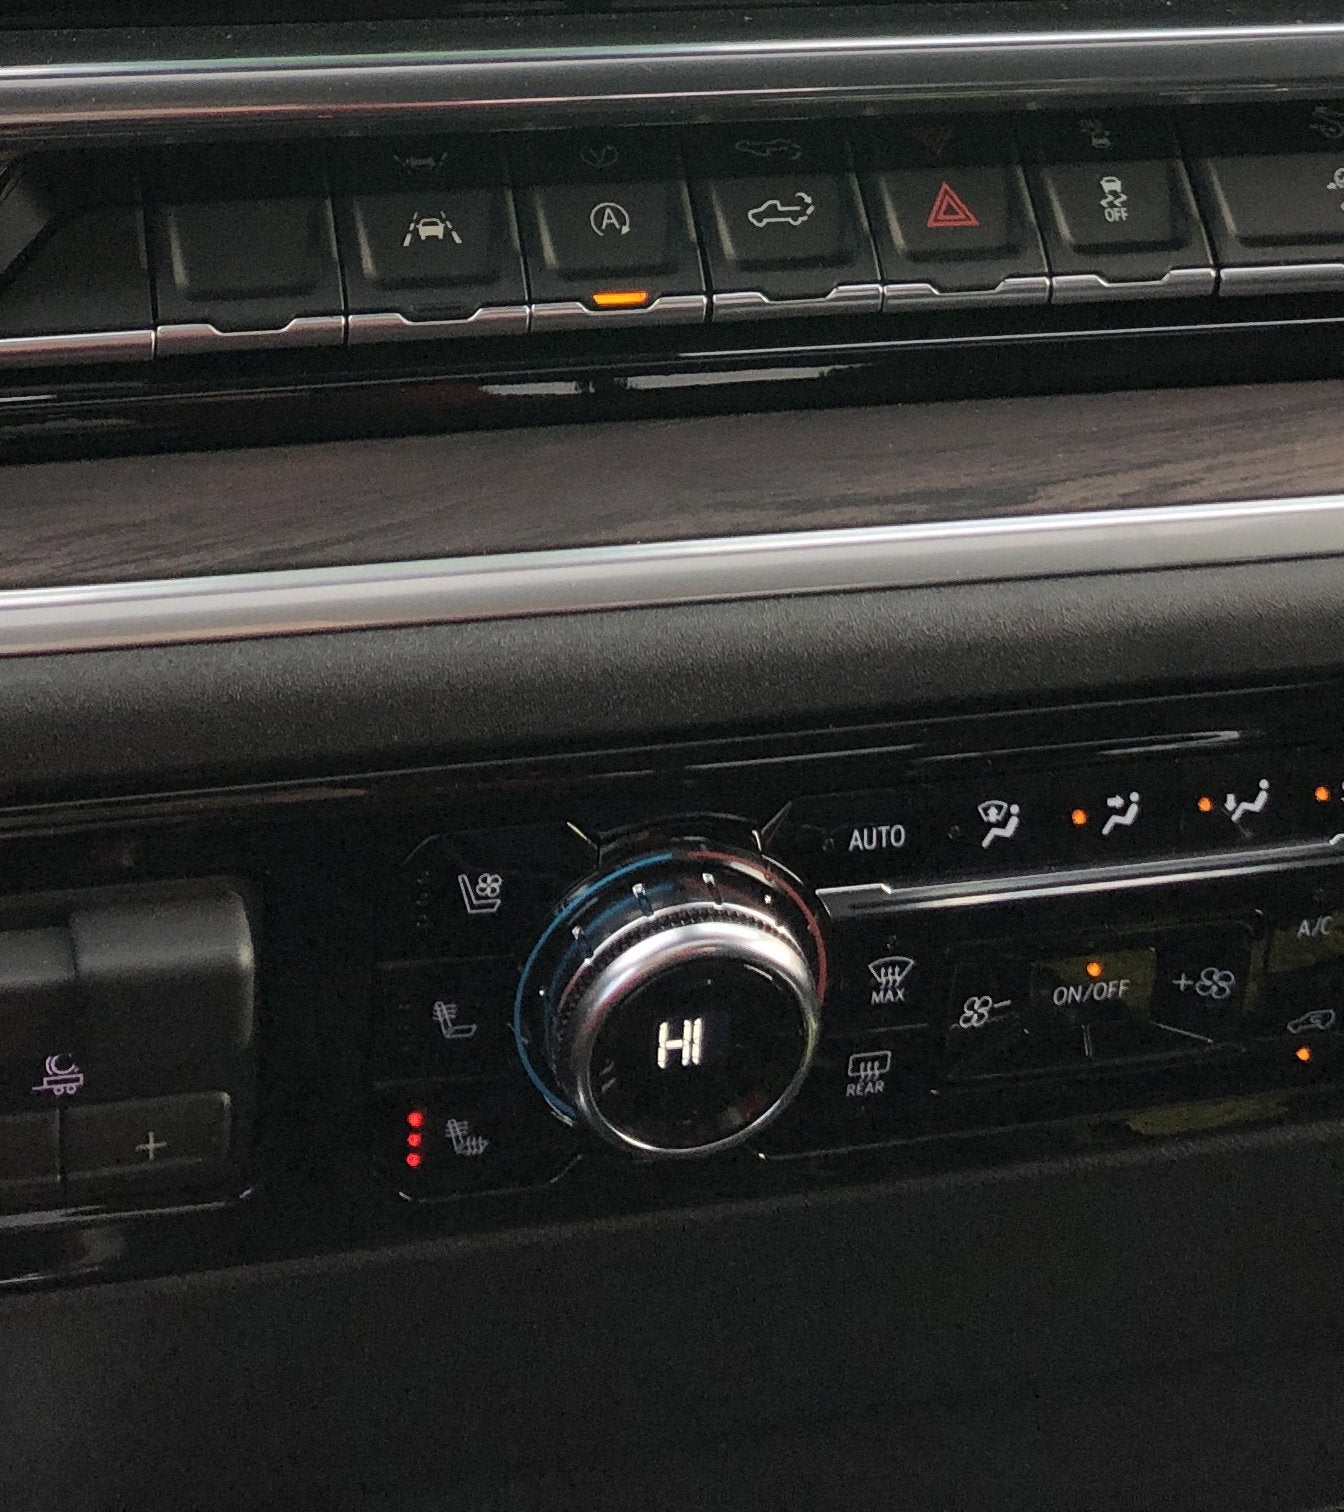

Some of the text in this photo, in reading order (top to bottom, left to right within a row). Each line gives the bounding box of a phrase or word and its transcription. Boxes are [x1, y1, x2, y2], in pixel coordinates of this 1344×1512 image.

[1104, 207, 1129, 223] OFF
[849, 824, 906, 852] AUTO
[1296, 914, 1335, 939] A/C
[871, 986, 906, 1005] MAX
[1053, 978, 1131, 1006] ON/OFF
[657, 1017, 703, 1069] HI
[846, 1079, 886, 1097] REAR
